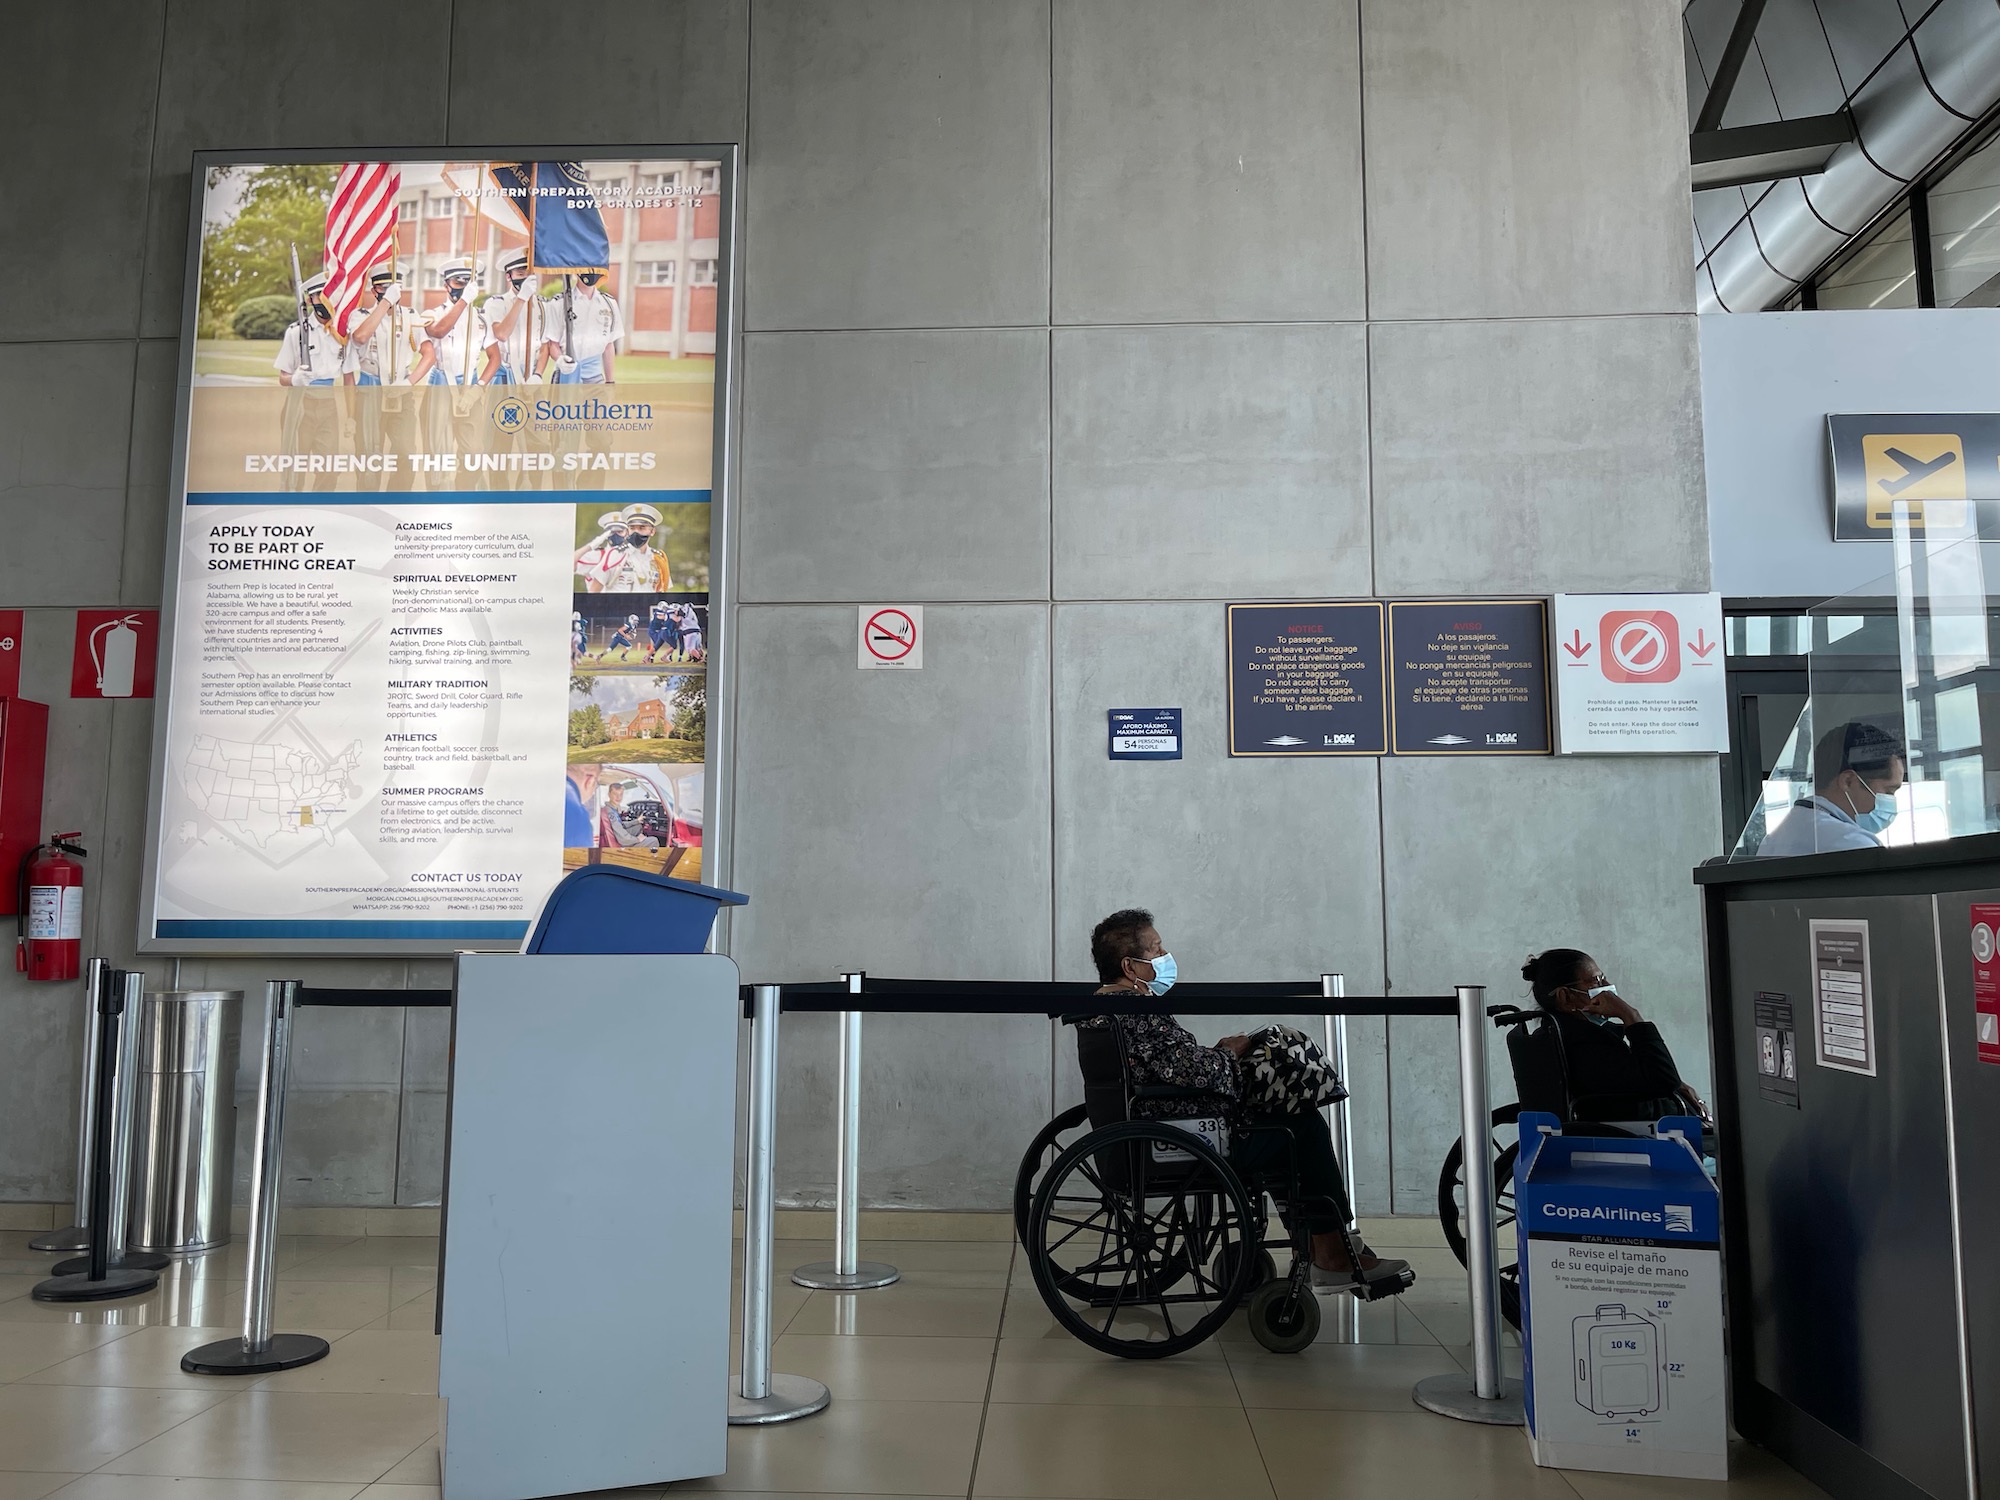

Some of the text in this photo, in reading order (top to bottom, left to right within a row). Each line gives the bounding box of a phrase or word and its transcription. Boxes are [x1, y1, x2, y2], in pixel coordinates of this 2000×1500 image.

[454, 186, 703, 198] SOUTHERN PREPARATORY ACADEMY
[567, 199, 603, 209] BOYS
[607, 199, 661, 209] GRADES
[665, 198, 674, 208] 6
[688, 198, 703, 208] 12
[535, 399, 653, 421] Southern
[535, 421, 653, 432] PREPARATORY ACADEMY
[245, 452, 656, 472] EXPERIENCE THE UNITED STATES
[210, 526, 315, 537] APPLY TODAY
[395, 523, 452, 531] ACADEMICS
[394, 534, 412, 543] Fully
[487, 533, 496, 541] of
[209, 542, 324, 554] TO BE PART OF
[208, 559, 356, 570] SOMETHING GREAT
[393, 574, 517, 583] SPIRITUAL DEVELOPMENT
[243, 582, 260, 591] Prep
[307, 582, 334, 590] Central
[206, 609, 238, 617] 320-acre
[270, 609, 286, 617] and
[286, 609, 304, 617] offer
[312, 609, 327, 617] safe
[391, 606, 406, 614] and
[407, 606, 438, 614] Catholic
[459, 606, 493, 614] available.
[390, 627, 443, 635] ACTIVITIES
[1288, 625, 1323, 633] NOTICE
[1288, 637, 1335, 645] passengers:
[1458, 634, 1498, 642] pasajeros:
[1255, 646, 1267, 654] Do
[1323, 646, 1358, 655] baggage
[1441, 643, 1458, 652] deje
[1473, 643, 1509, 652] vigilancia
[1458, 654, 1492, 662] equipaje.
[1276, 662, 1297, 671] place
[1298, 662, 1340, 672] dangerous
[1341, 661, 1365, 671] goods
[1492, 661, 1532, 670] peligrosas
[1305, 670, 1340, 679] baggage.
[388, 680, 488, 688] MILITARY TRADITION
[1428, 677, 1512, 687] No acepte transportar
[1253, 695, 1259, 703] If
[1299, 695, 1325, 704] please
[385, 734, 437, 742] ATHLETICS
[382, 787, 484, 795] SUMMER PROGRAMS
[411, 873, 523, 883] CONTACT US TODAY
[1978, 928, 1990, 957] 3
[1198, 1120, 1216, 1132] 33
[1543, 1204, 1662, 1222] CopaAirlines
[1604, 1237, 1644, 1245] ALLIANCE
[1568, 1247, 1666, 1263] Revise el tamaño
[1551, 1258, 1689, 1277] de su equipaje de mano
[1657, 1300, 1672, 1309] 10"
[1611, 1340, 1636, 1350] 10 Kg
[1669, 1363, 1685, 1372] 22"
[1625, 1429, 1641, 1437] 14"
